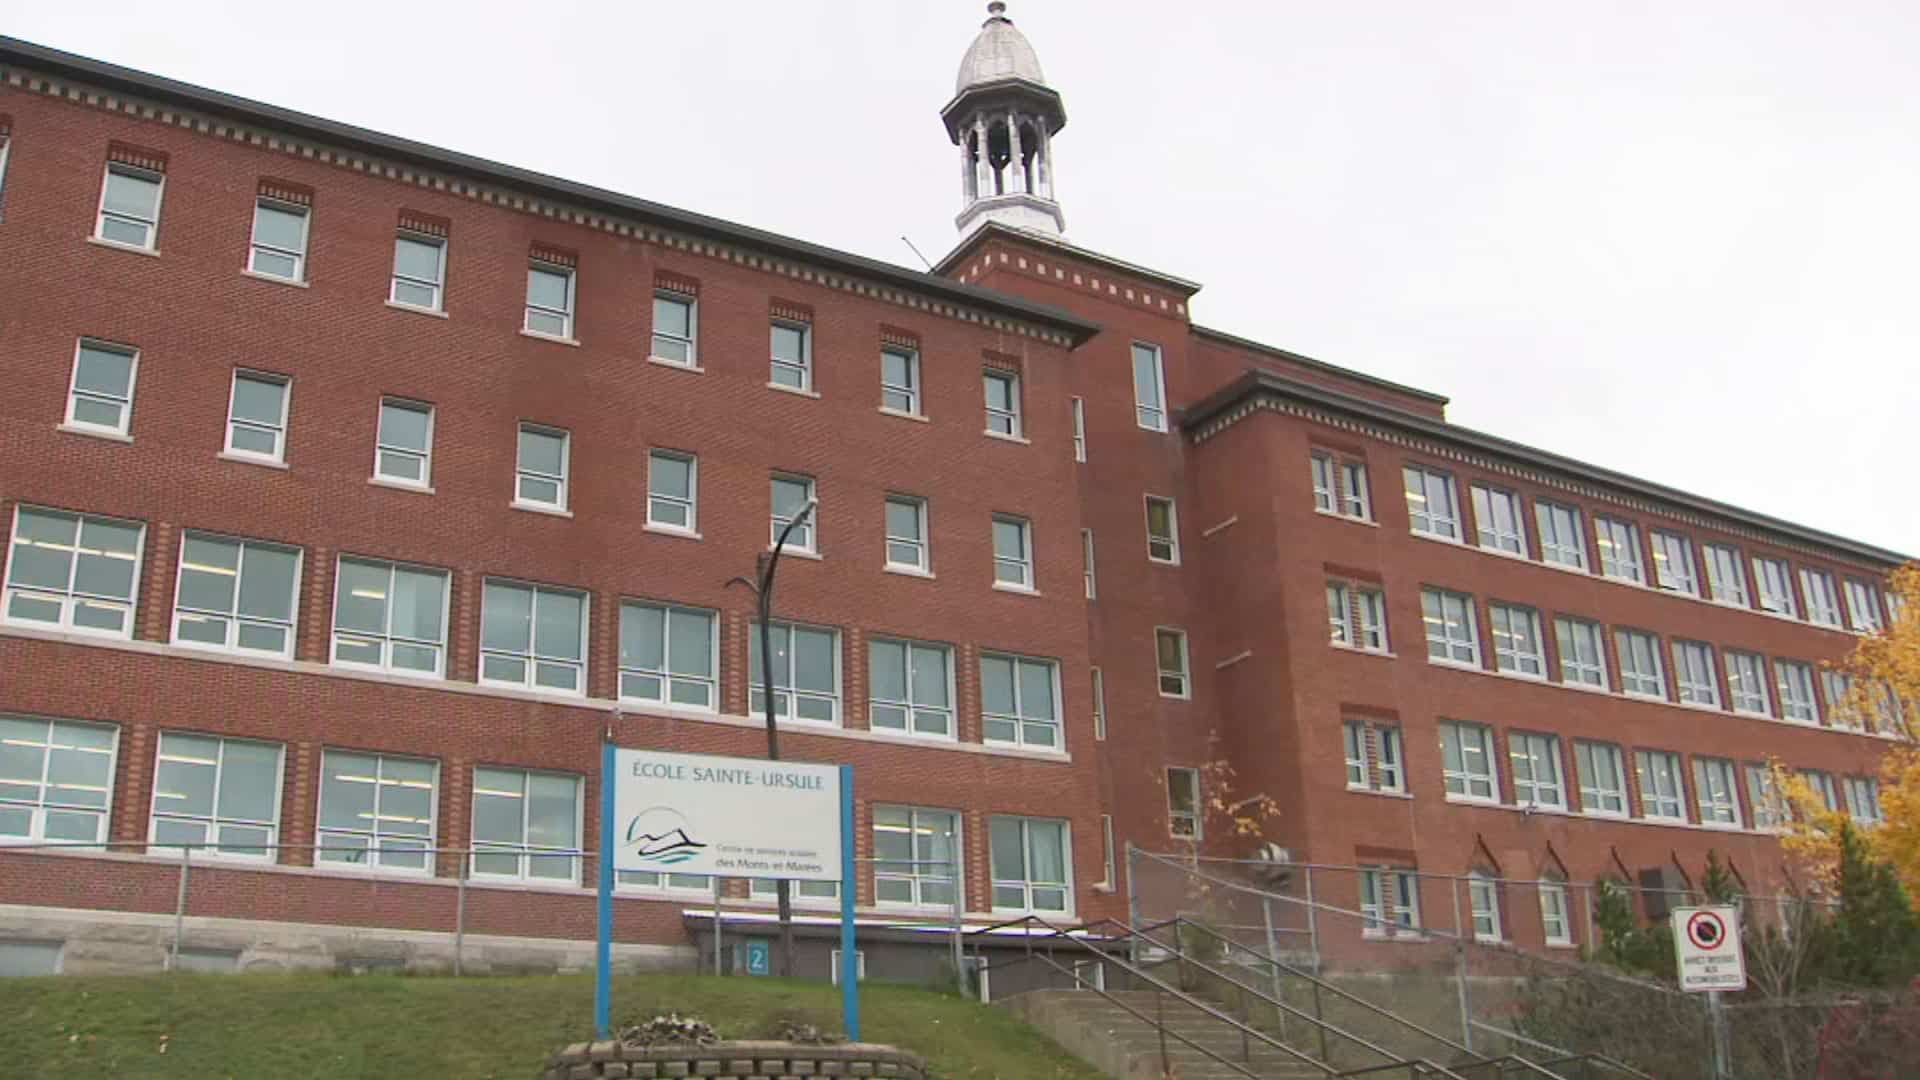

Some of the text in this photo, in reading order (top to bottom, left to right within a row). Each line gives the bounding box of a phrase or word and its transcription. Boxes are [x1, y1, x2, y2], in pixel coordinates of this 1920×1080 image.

[632, 762, 824, 790] ÉCOLE SAINTE-URSULE
[751, 949, 763, 969] 2
